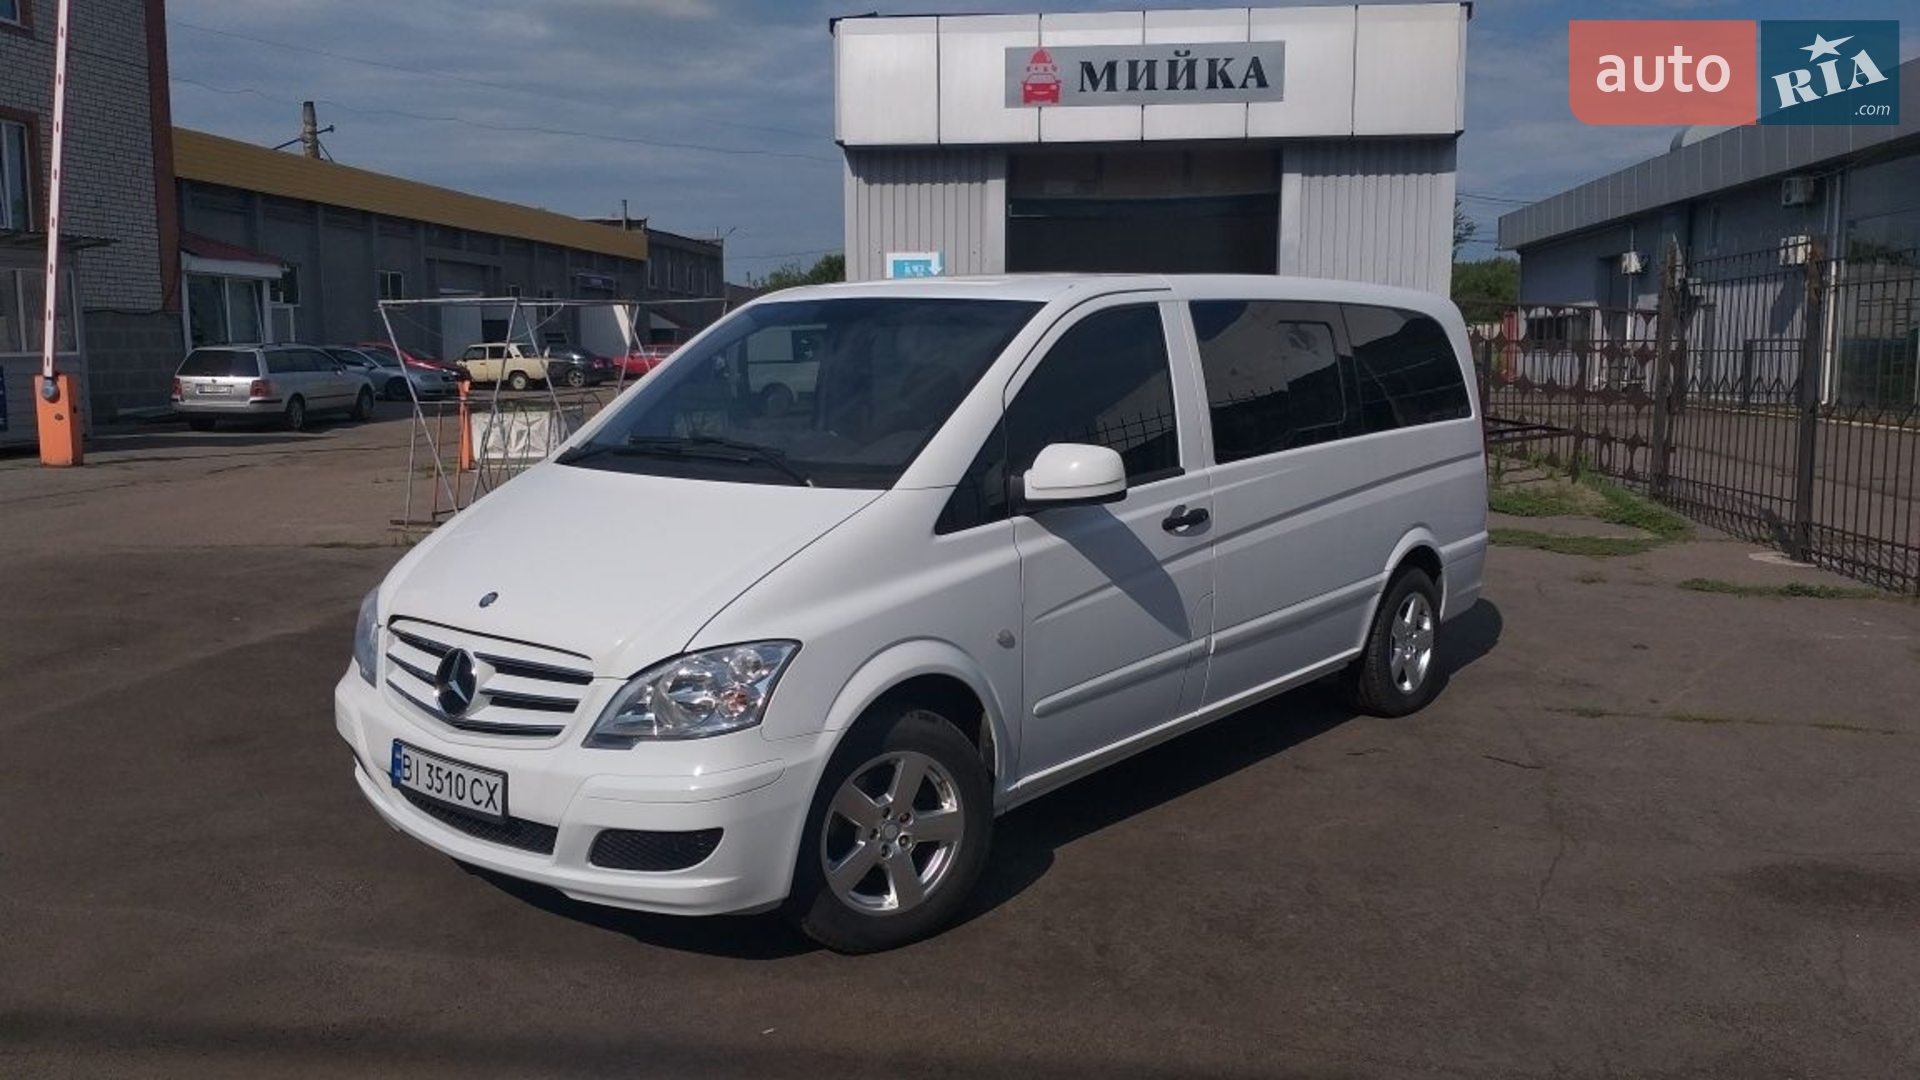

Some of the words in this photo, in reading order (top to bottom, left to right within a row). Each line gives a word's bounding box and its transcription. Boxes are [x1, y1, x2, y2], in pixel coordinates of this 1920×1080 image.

[1078, 49, 1270, 92] МИЙКА
[402, 754, 420, 785] BI
[425, 763, 466, 801] 3510
[470, 777, 499, 811] CX
